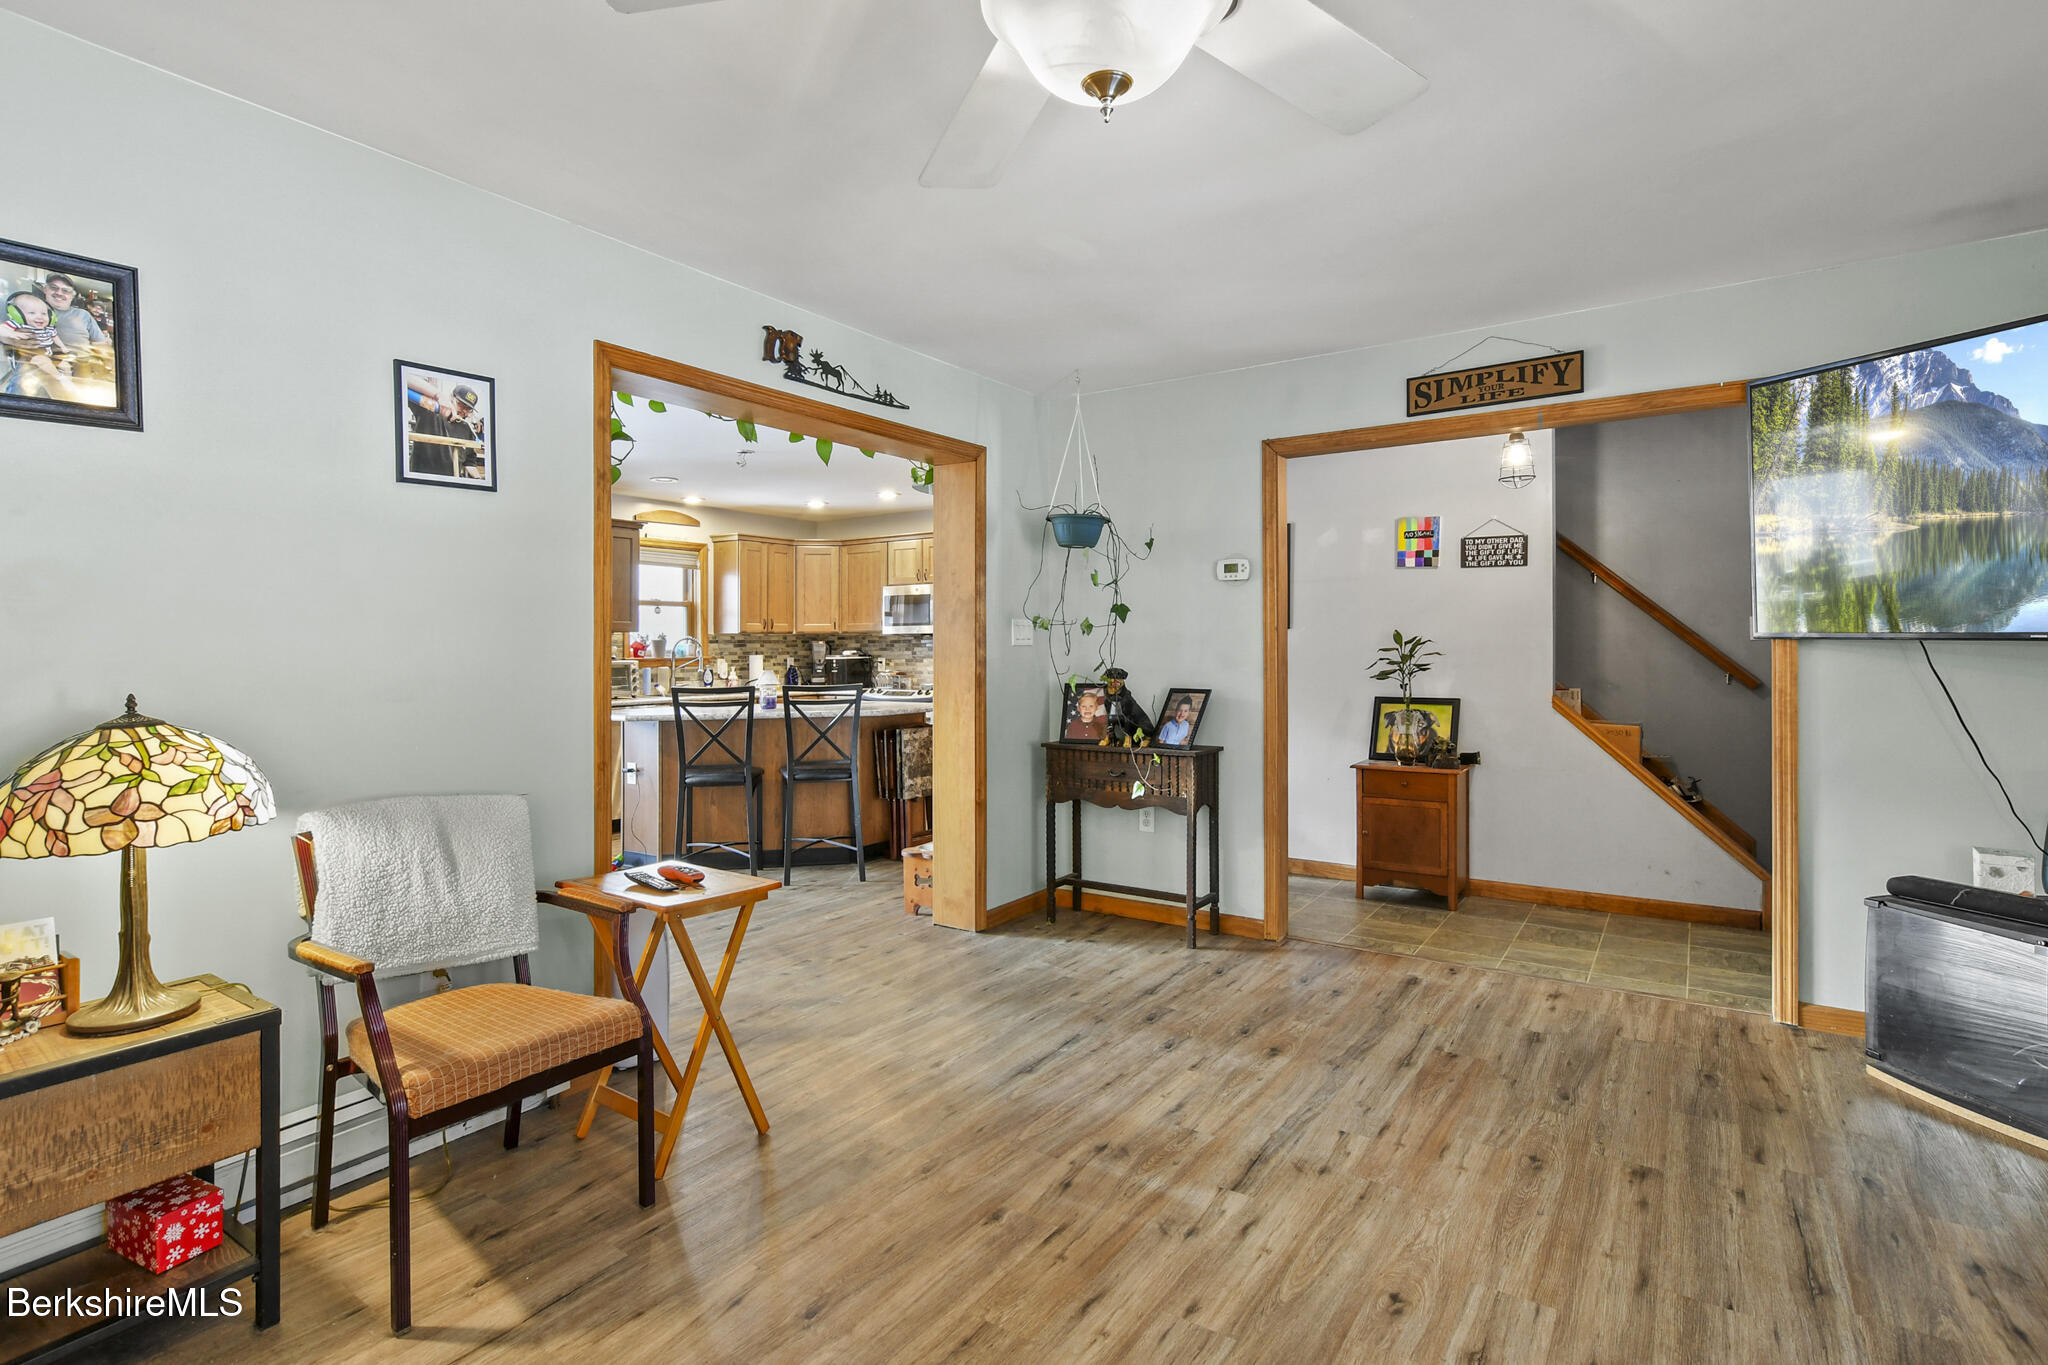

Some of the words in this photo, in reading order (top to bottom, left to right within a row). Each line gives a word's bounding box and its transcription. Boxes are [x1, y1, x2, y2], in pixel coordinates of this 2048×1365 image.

[1414, 358, 1575, 410] SIMPLIFY
[1478, 383, 1505, 393] YOUR
[1461, 387, 1525, 404] LIFE
